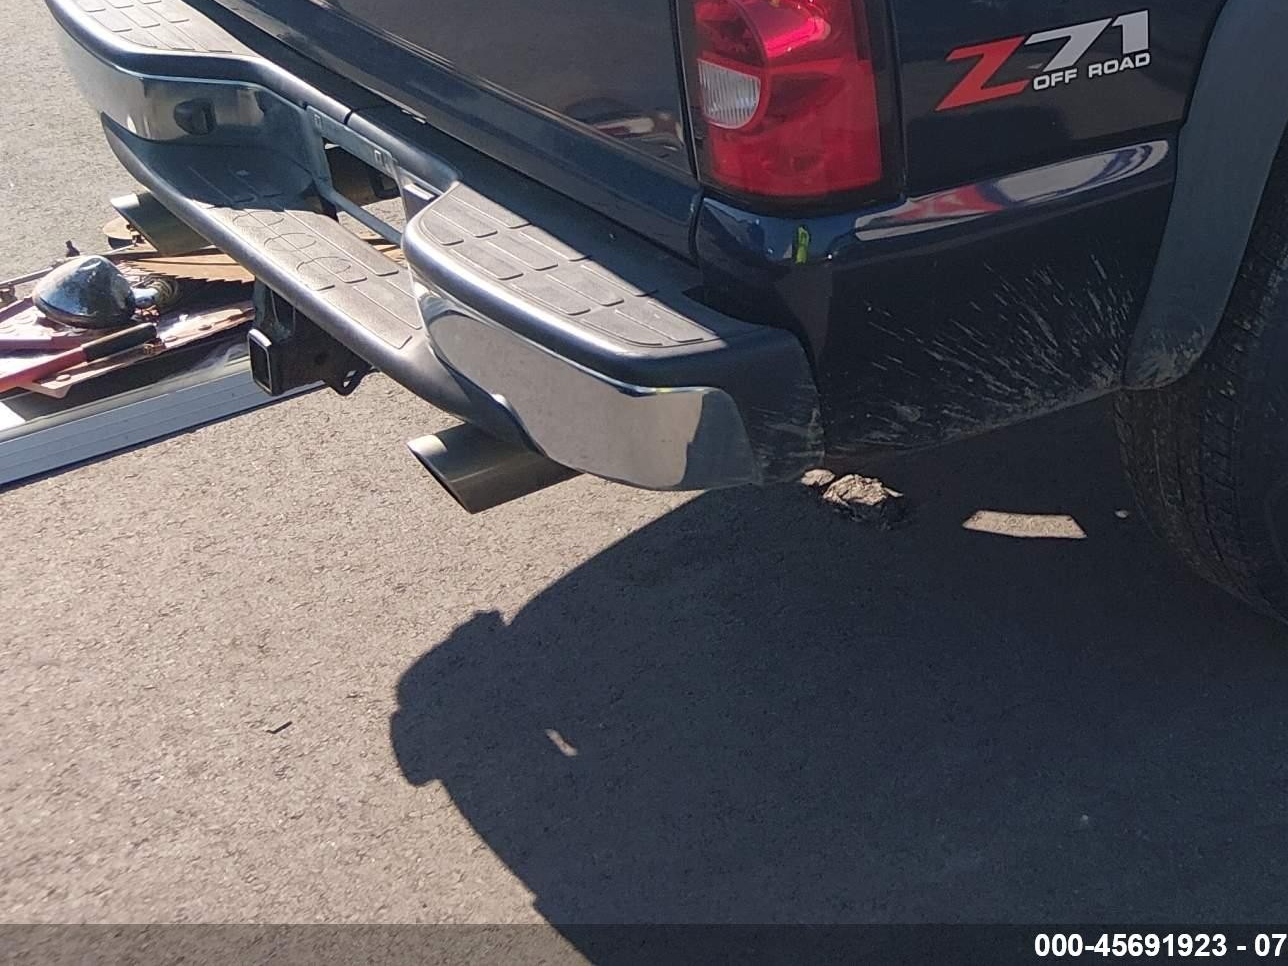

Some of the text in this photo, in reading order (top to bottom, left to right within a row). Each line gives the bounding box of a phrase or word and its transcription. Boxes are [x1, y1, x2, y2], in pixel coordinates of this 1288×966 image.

[934, 10, 1150, 111] Z71
[1033, 53, 1151, 91] OFF ROAD
